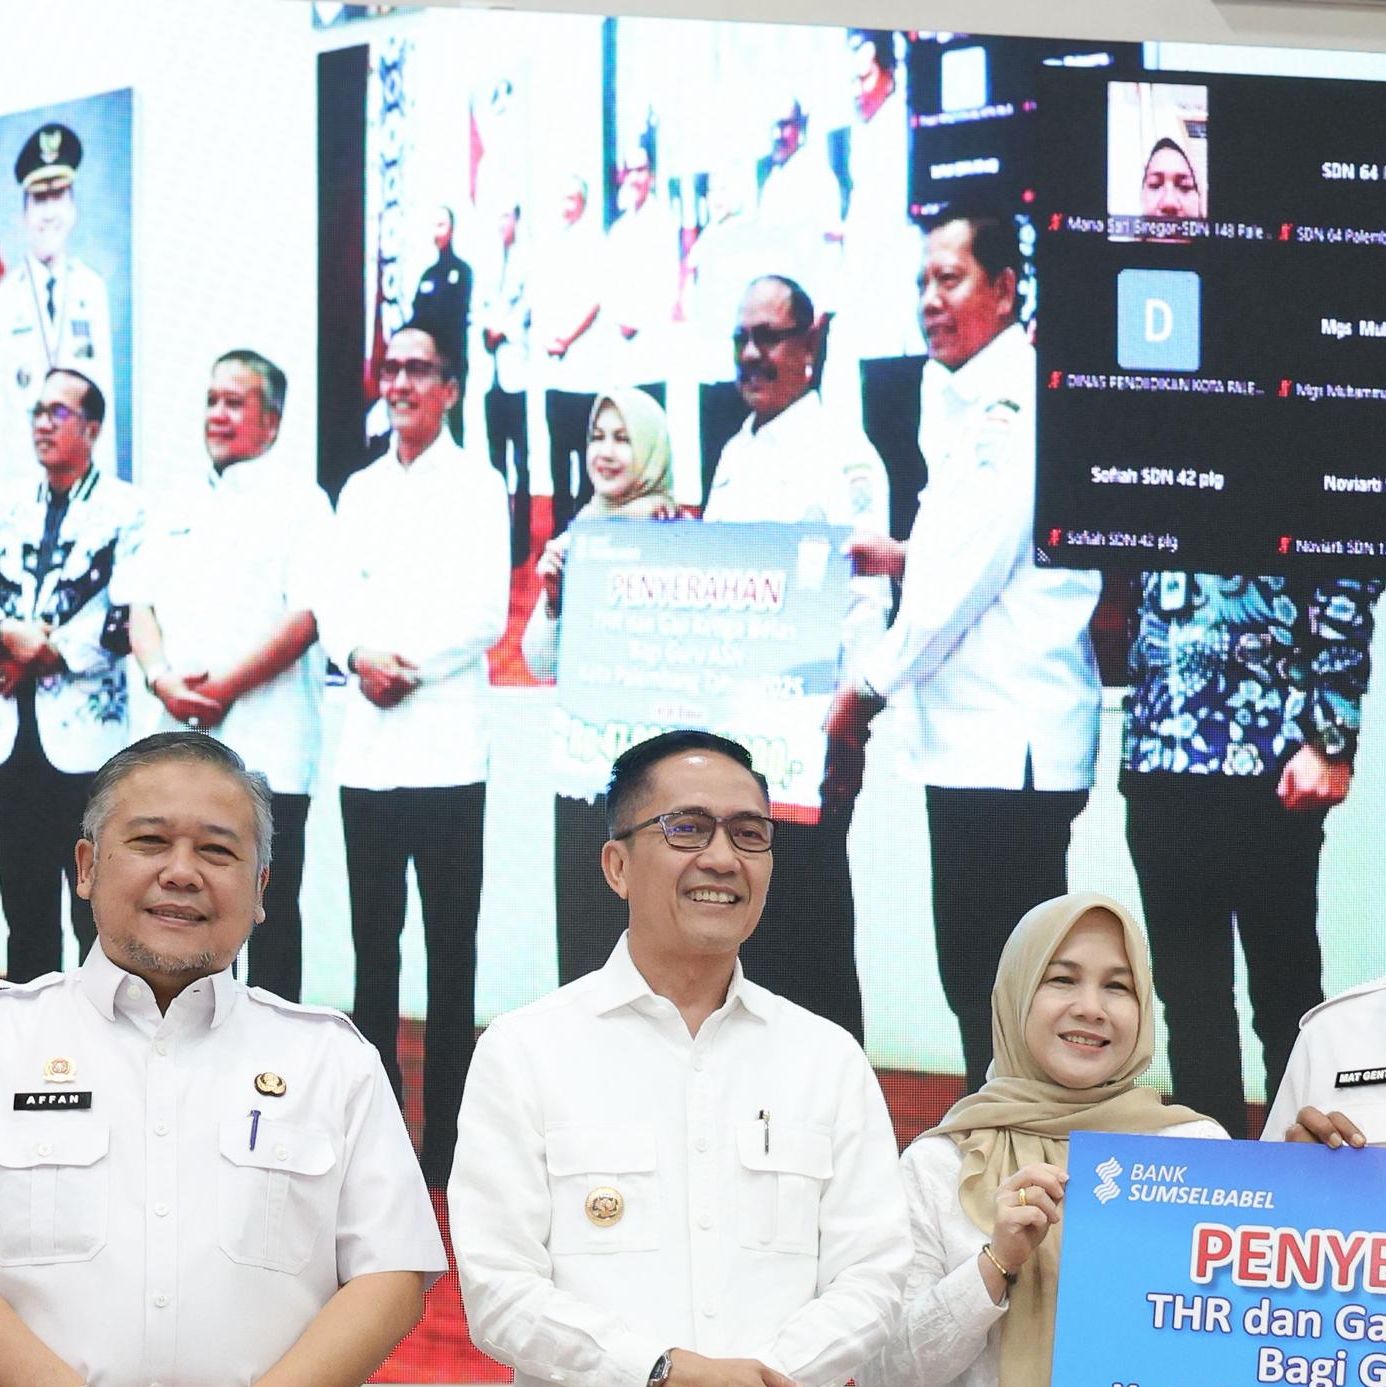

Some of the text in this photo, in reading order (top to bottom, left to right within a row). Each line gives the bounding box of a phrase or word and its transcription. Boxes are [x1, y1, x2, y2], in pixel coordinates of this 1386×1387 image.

[1321, 162, 1355, 180] SDN
[1359, 163, 1379, 180] 64
[1296, 226, 1324, 243] SDN
[1326, 227, 1342, 243] 64
[1145, 298, 1173, 342] D
[1141, 466, 1174, 486] SDN
[1176, 467, 1197, 487] 42
[1198, 469, 1225, 491] plg
[1109, 531, 1137, 547] SDN
[1138, 532, 1155, 547] 42
[1157, 533, 1178, 553] plg
[1346, 539, 1374, 555] SDN
[1339, 1072, 1362, 1083] MAT
[26, 1095, 79, 1105] AFFAN
[1130, 1163, 1188, 1183] BANK
[1128, 1183, 1275, 1209] SUMSELBABEL
[1147, 1294, 1231, 1334] THR
[1243, 1298, 1322, 1339] dan
